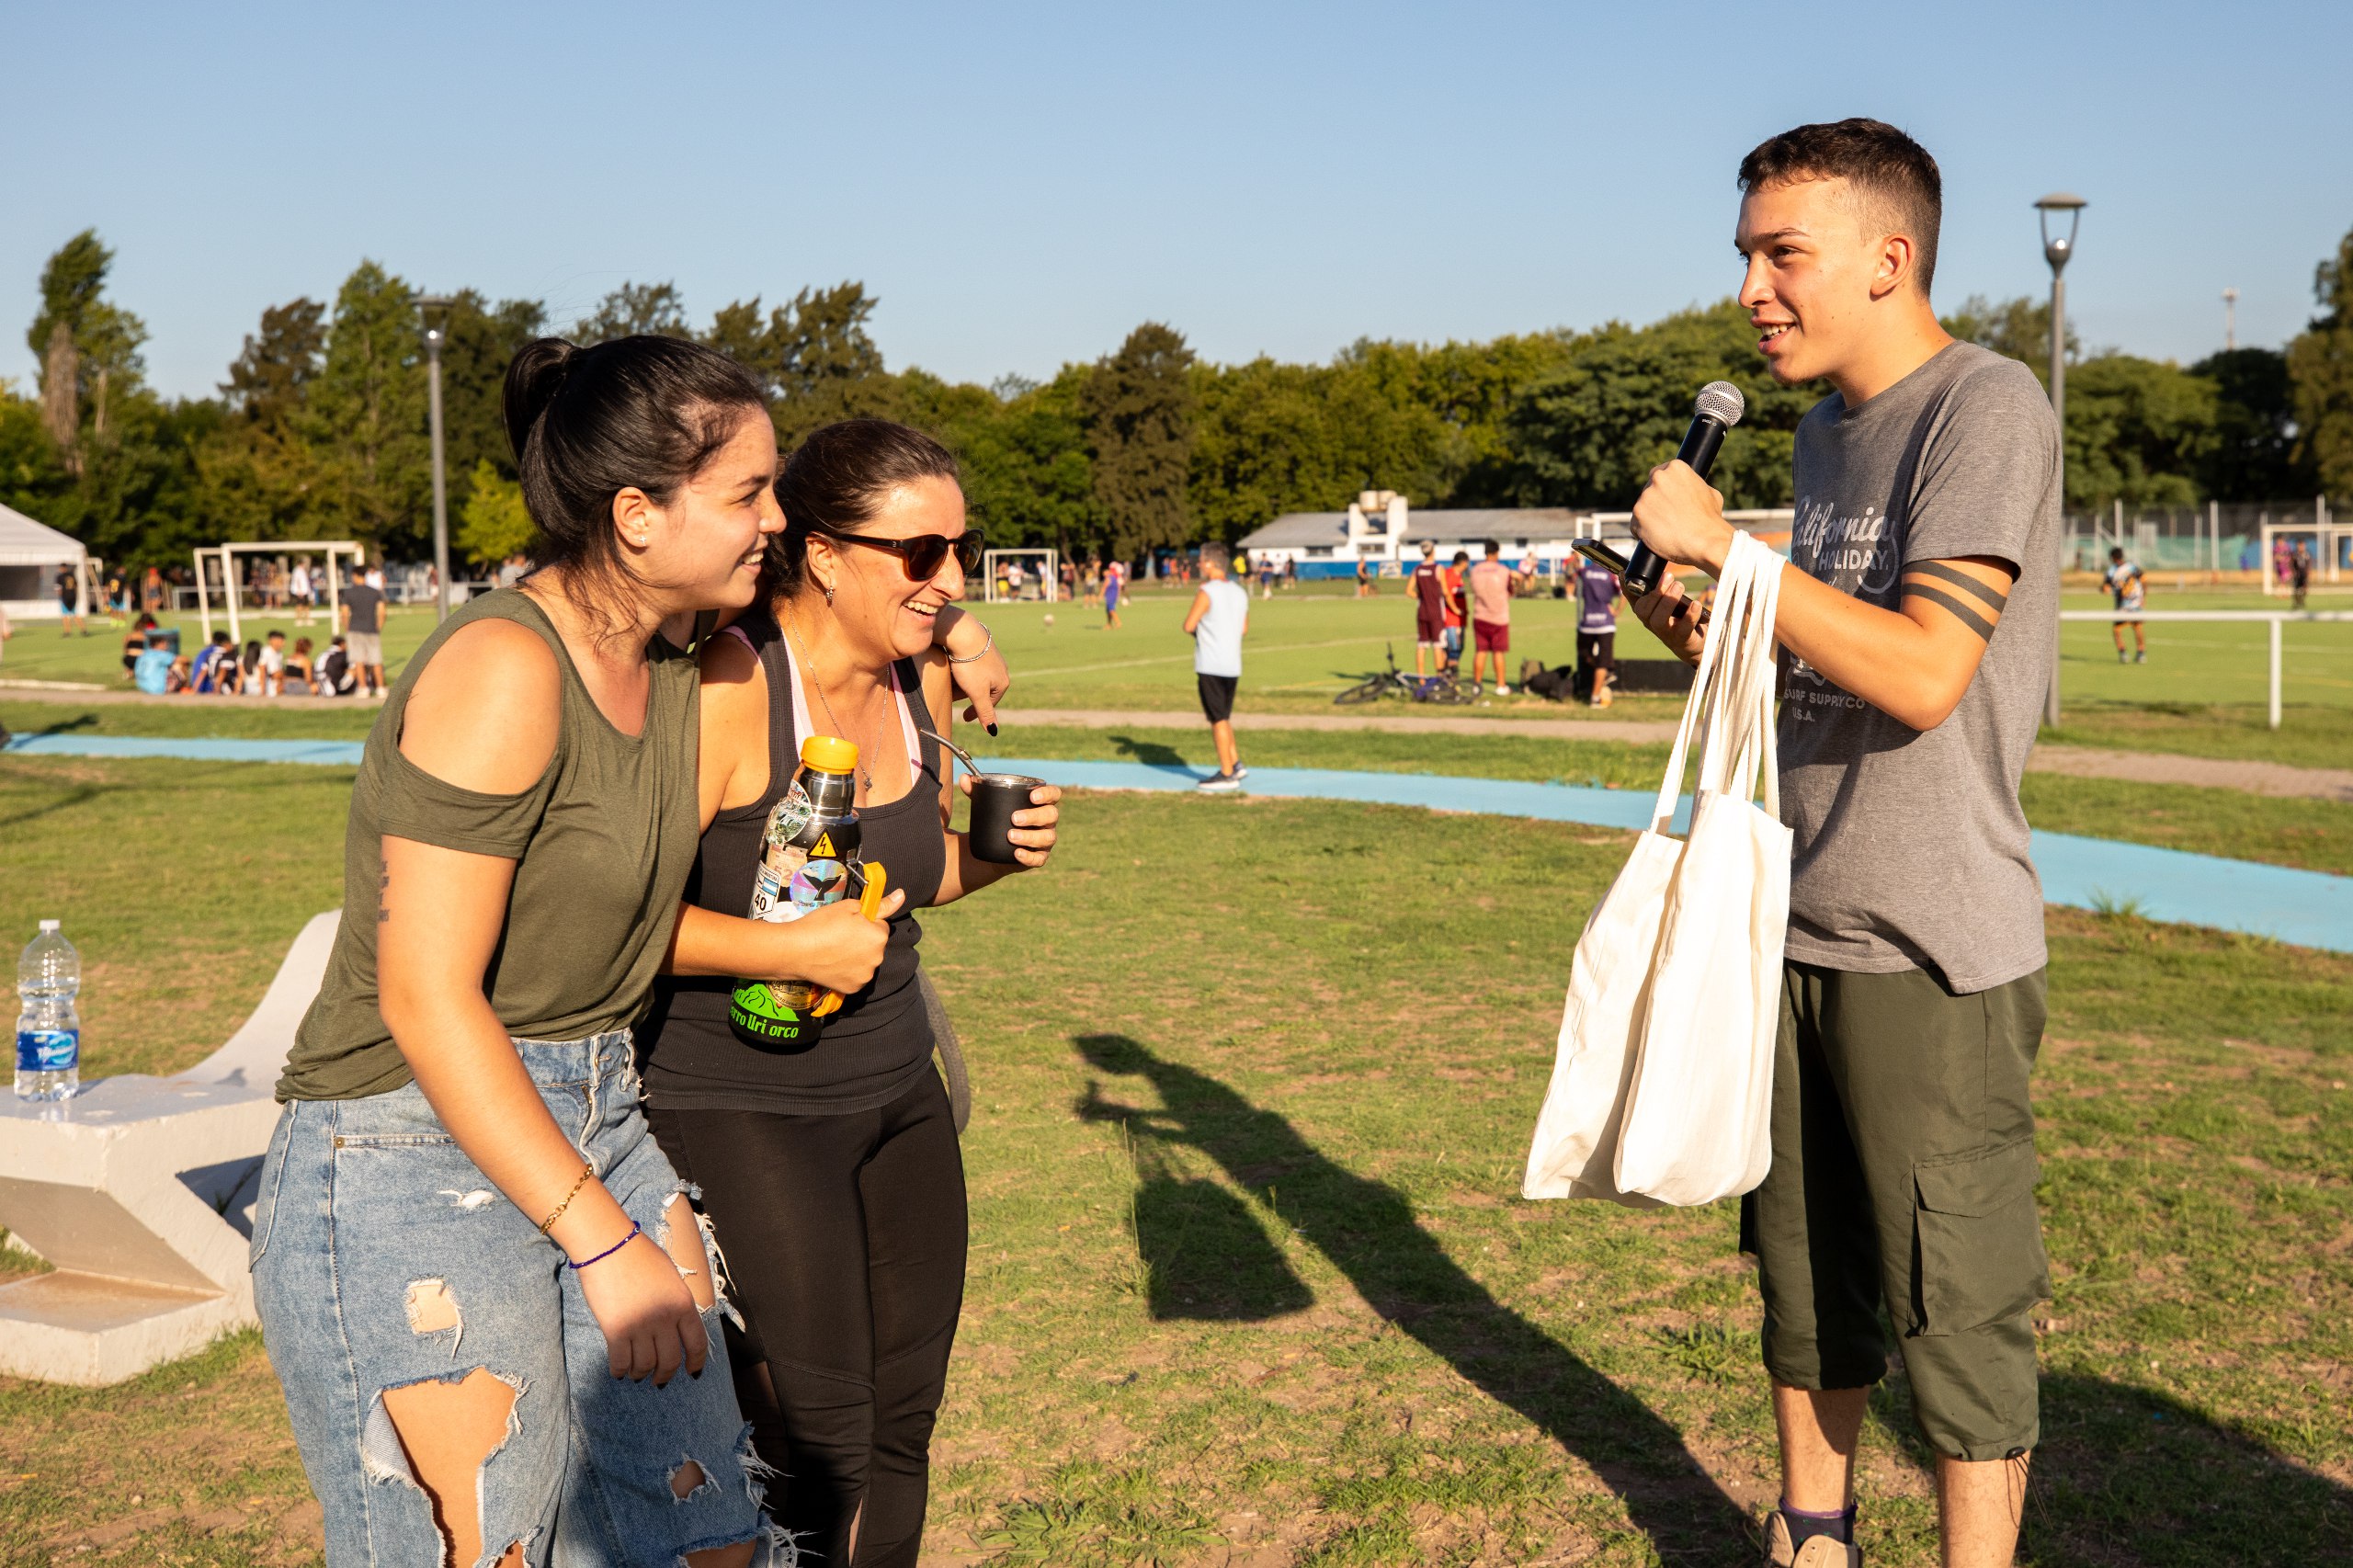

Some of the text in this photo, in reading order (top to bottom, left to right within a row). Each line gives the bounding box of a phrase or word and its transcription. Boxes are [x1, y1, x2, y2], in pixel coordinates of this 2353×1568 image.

[755, 893, 767, 911] 40
[747, 1014, 767, 1034] Uri
[768, 1025, 799, 1039] orco
